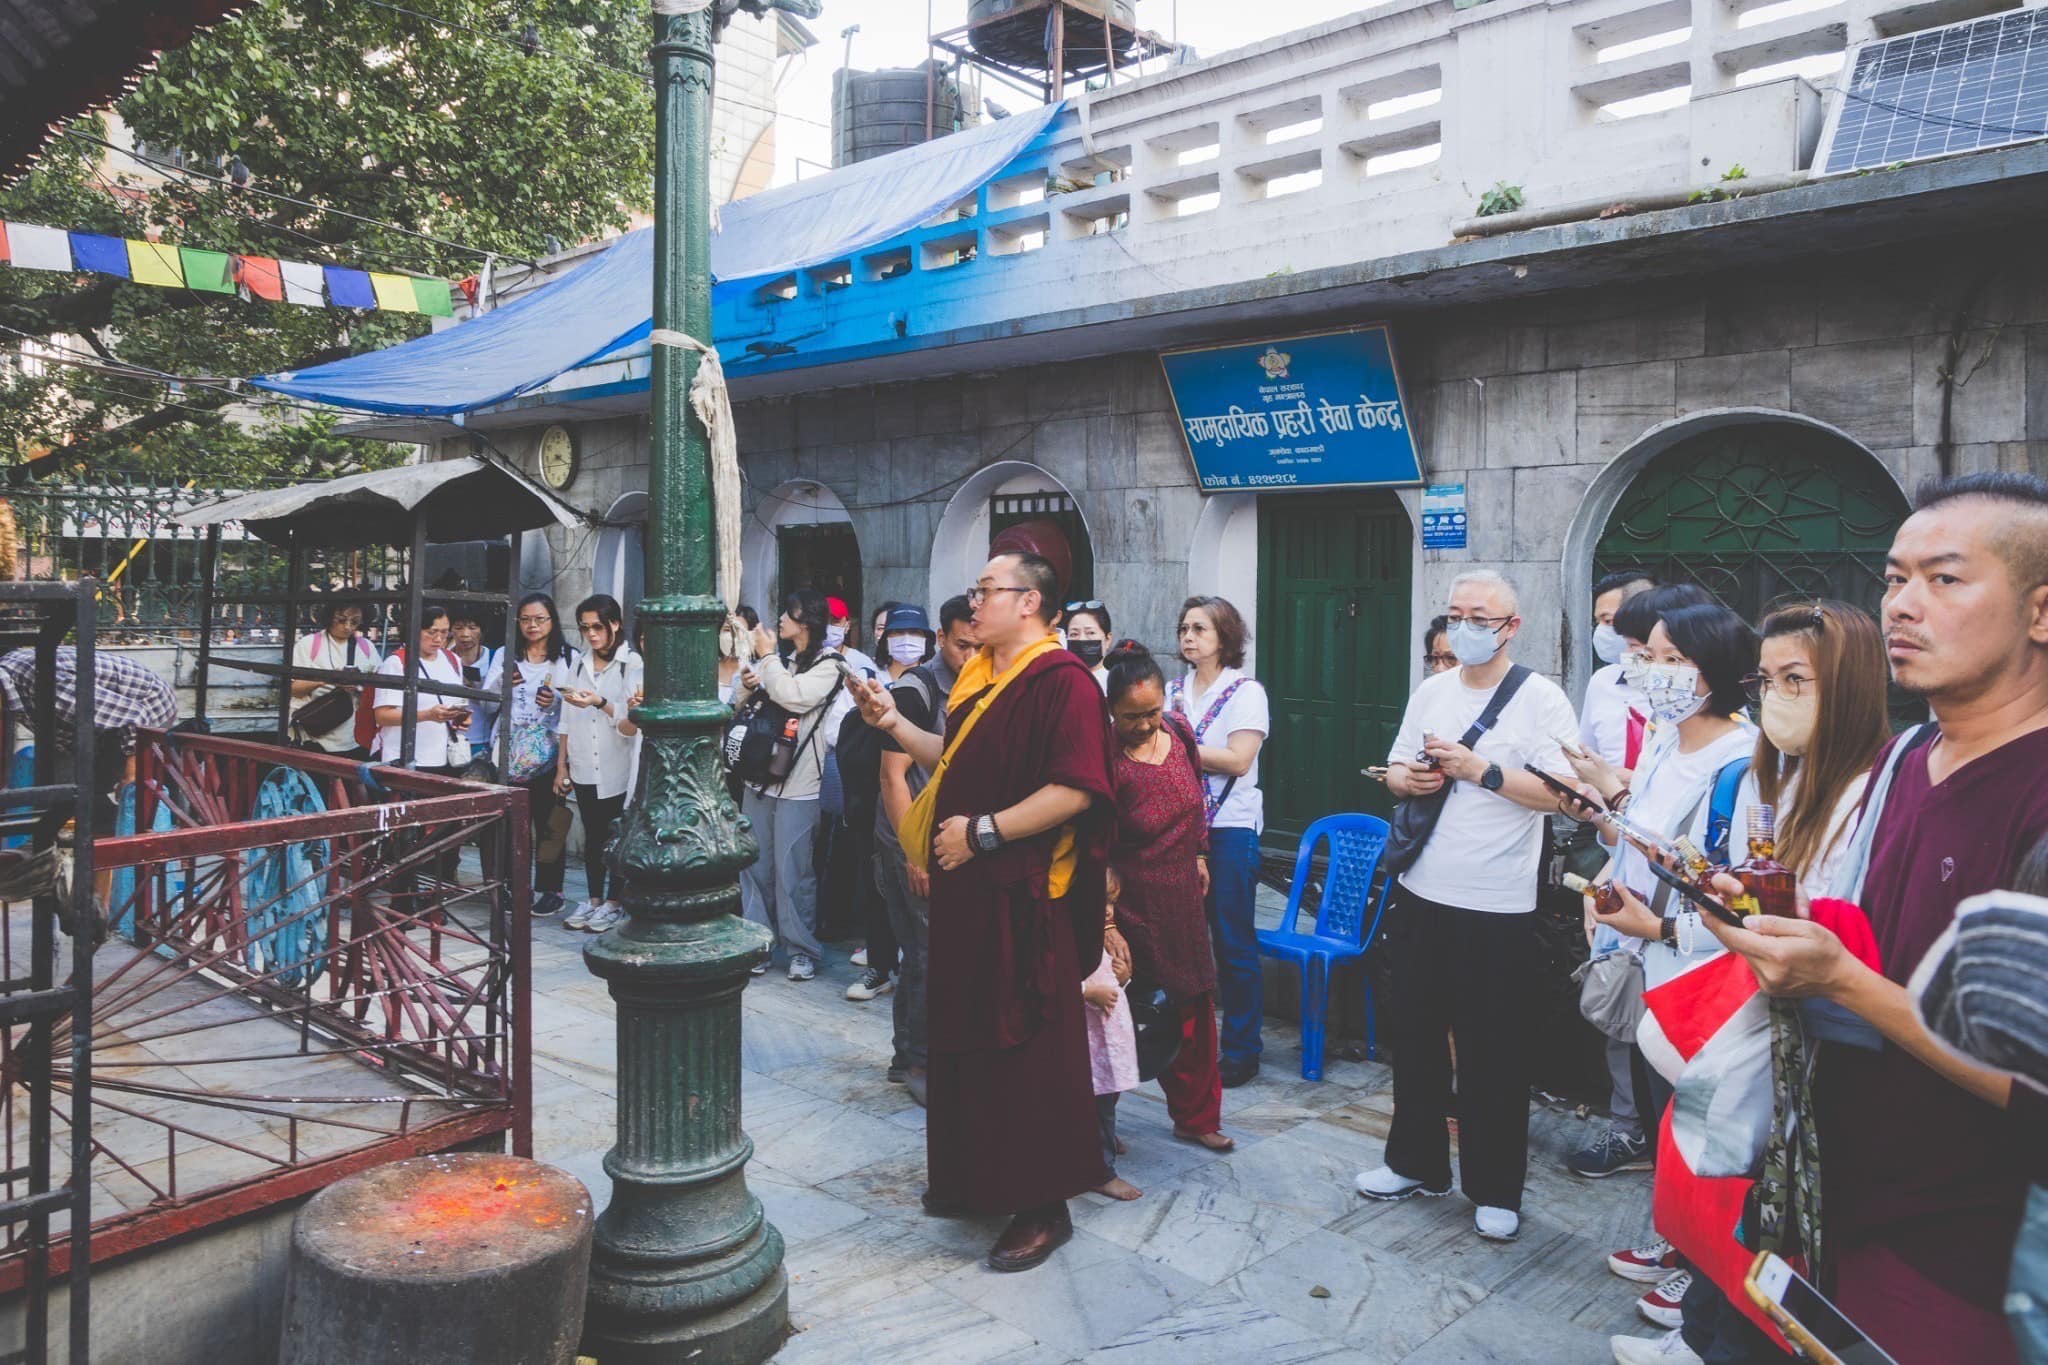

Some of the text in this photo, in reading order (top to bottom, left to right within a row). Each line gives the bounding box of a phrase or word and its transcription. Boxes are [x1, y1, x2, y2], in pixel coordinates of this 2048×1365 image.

[1184, 393, 1403, 448] सामुदायिक प्रहरी सेवा केन्द्र
[1203, 474, 1229, 486] फोन
